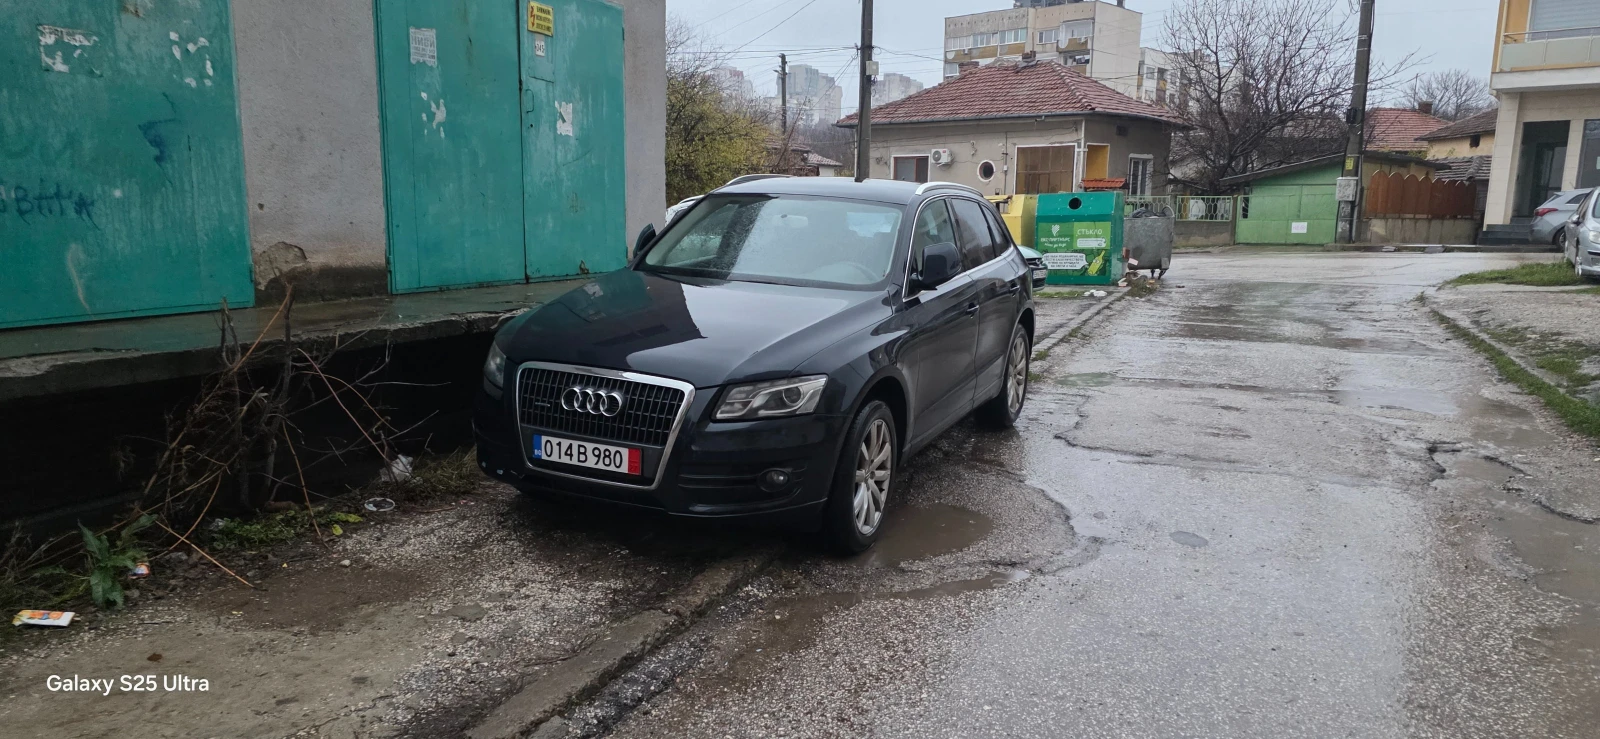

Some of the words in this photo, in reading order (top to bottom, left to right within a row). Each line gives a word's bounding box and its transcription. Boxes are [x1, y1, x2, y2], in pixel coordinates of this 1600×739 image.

[544, 439, 573, 461] 014
[577, 444, 588, 463] B
[592, 446, 623, 469] 980
